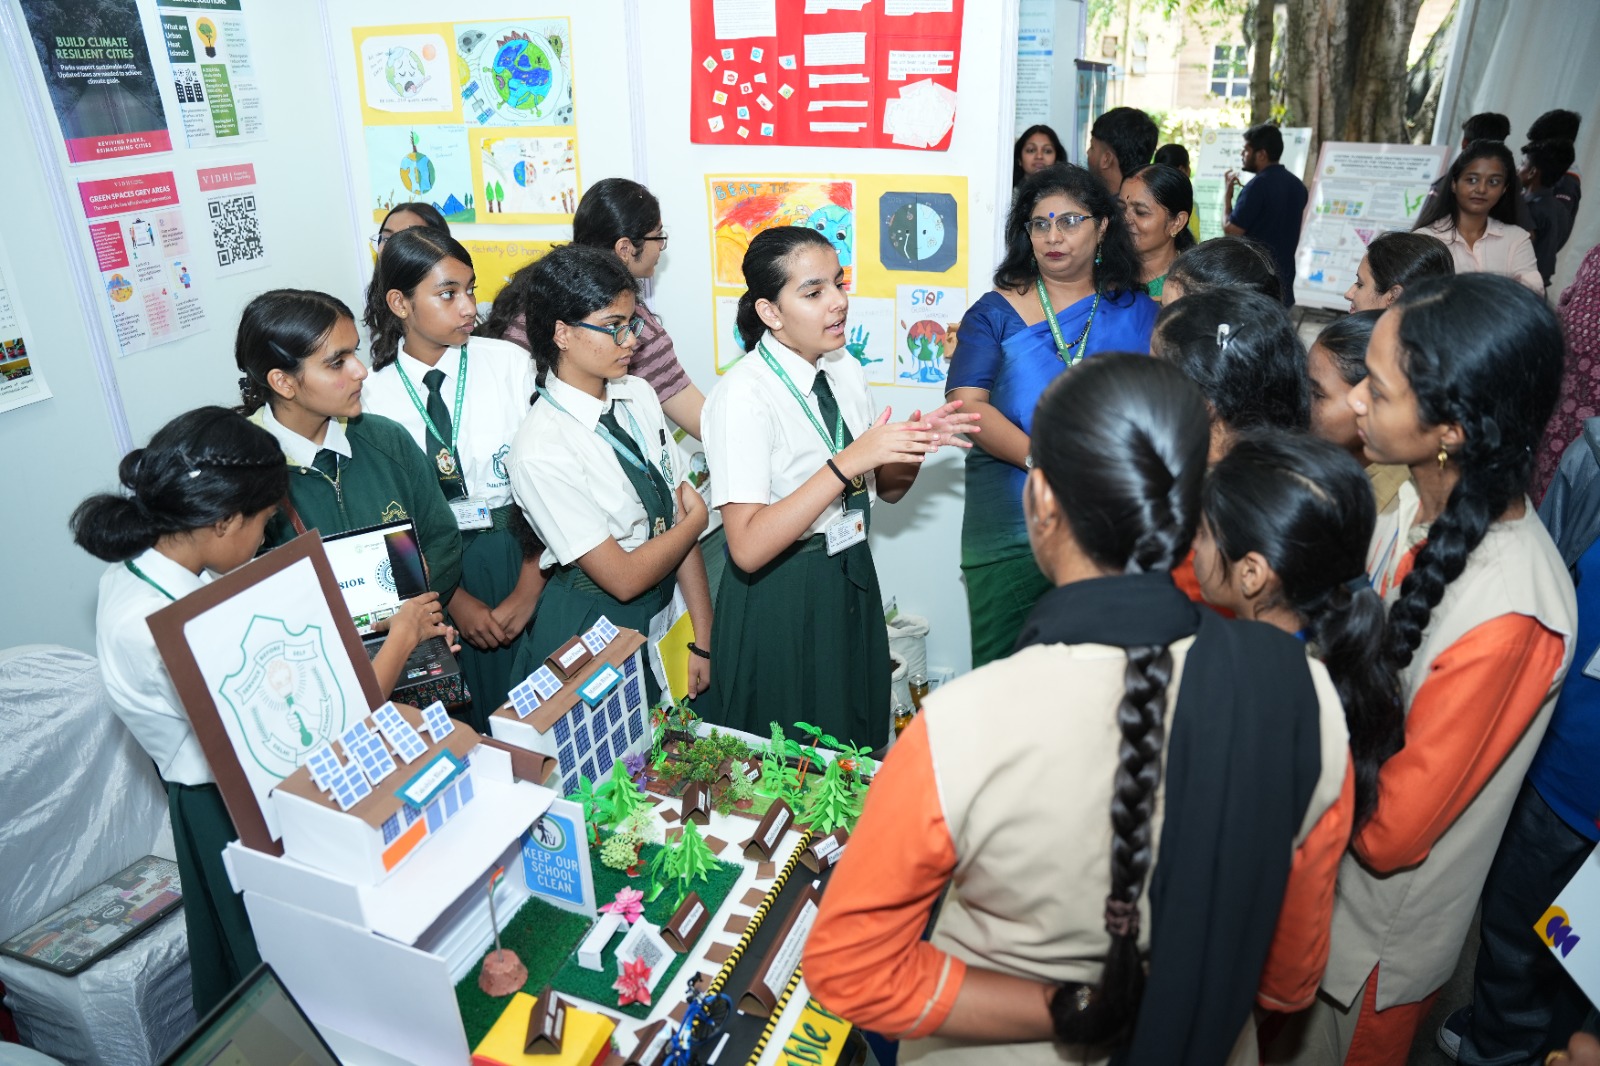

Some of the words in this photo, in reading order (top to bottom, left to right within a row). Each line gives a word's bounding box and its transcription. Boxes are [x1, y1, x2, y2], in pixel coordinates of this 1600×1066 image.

[56, 36, 86, 47] BUILD
[87, 37, 128, 47] CLIMATE
[55, 48, 104, 59] RESILIENT
[105, 48, 134, 59] CITIES
[96, 144, 134, 154] REIMAGINING
[202, 171, 233, 185] VIDHI
[89, 193, 111, 203] GREEN
[111, 190, 135, 200] SPACES
[135, 188, 151, 197] GREY
[151, 185, 170, 194] AREAS
[715, 183, 762, 201] BEAT
[911, 288, 945, 306] STOP
[258, 645, 282, 661] BEFORE
[292, 649, 307, 657] SELF
[322, 704, 331, 733] SCHOOL
[272, 743, 291, 758] DELHI
[817, 839, 837, 855] Cycling
[523, 847, 551, 864] KEEP
[555, 855, 579, 873] OUR
[531, 861, 575, 884] SCHOOL
[537, 874, 573, 895] CLEAN
